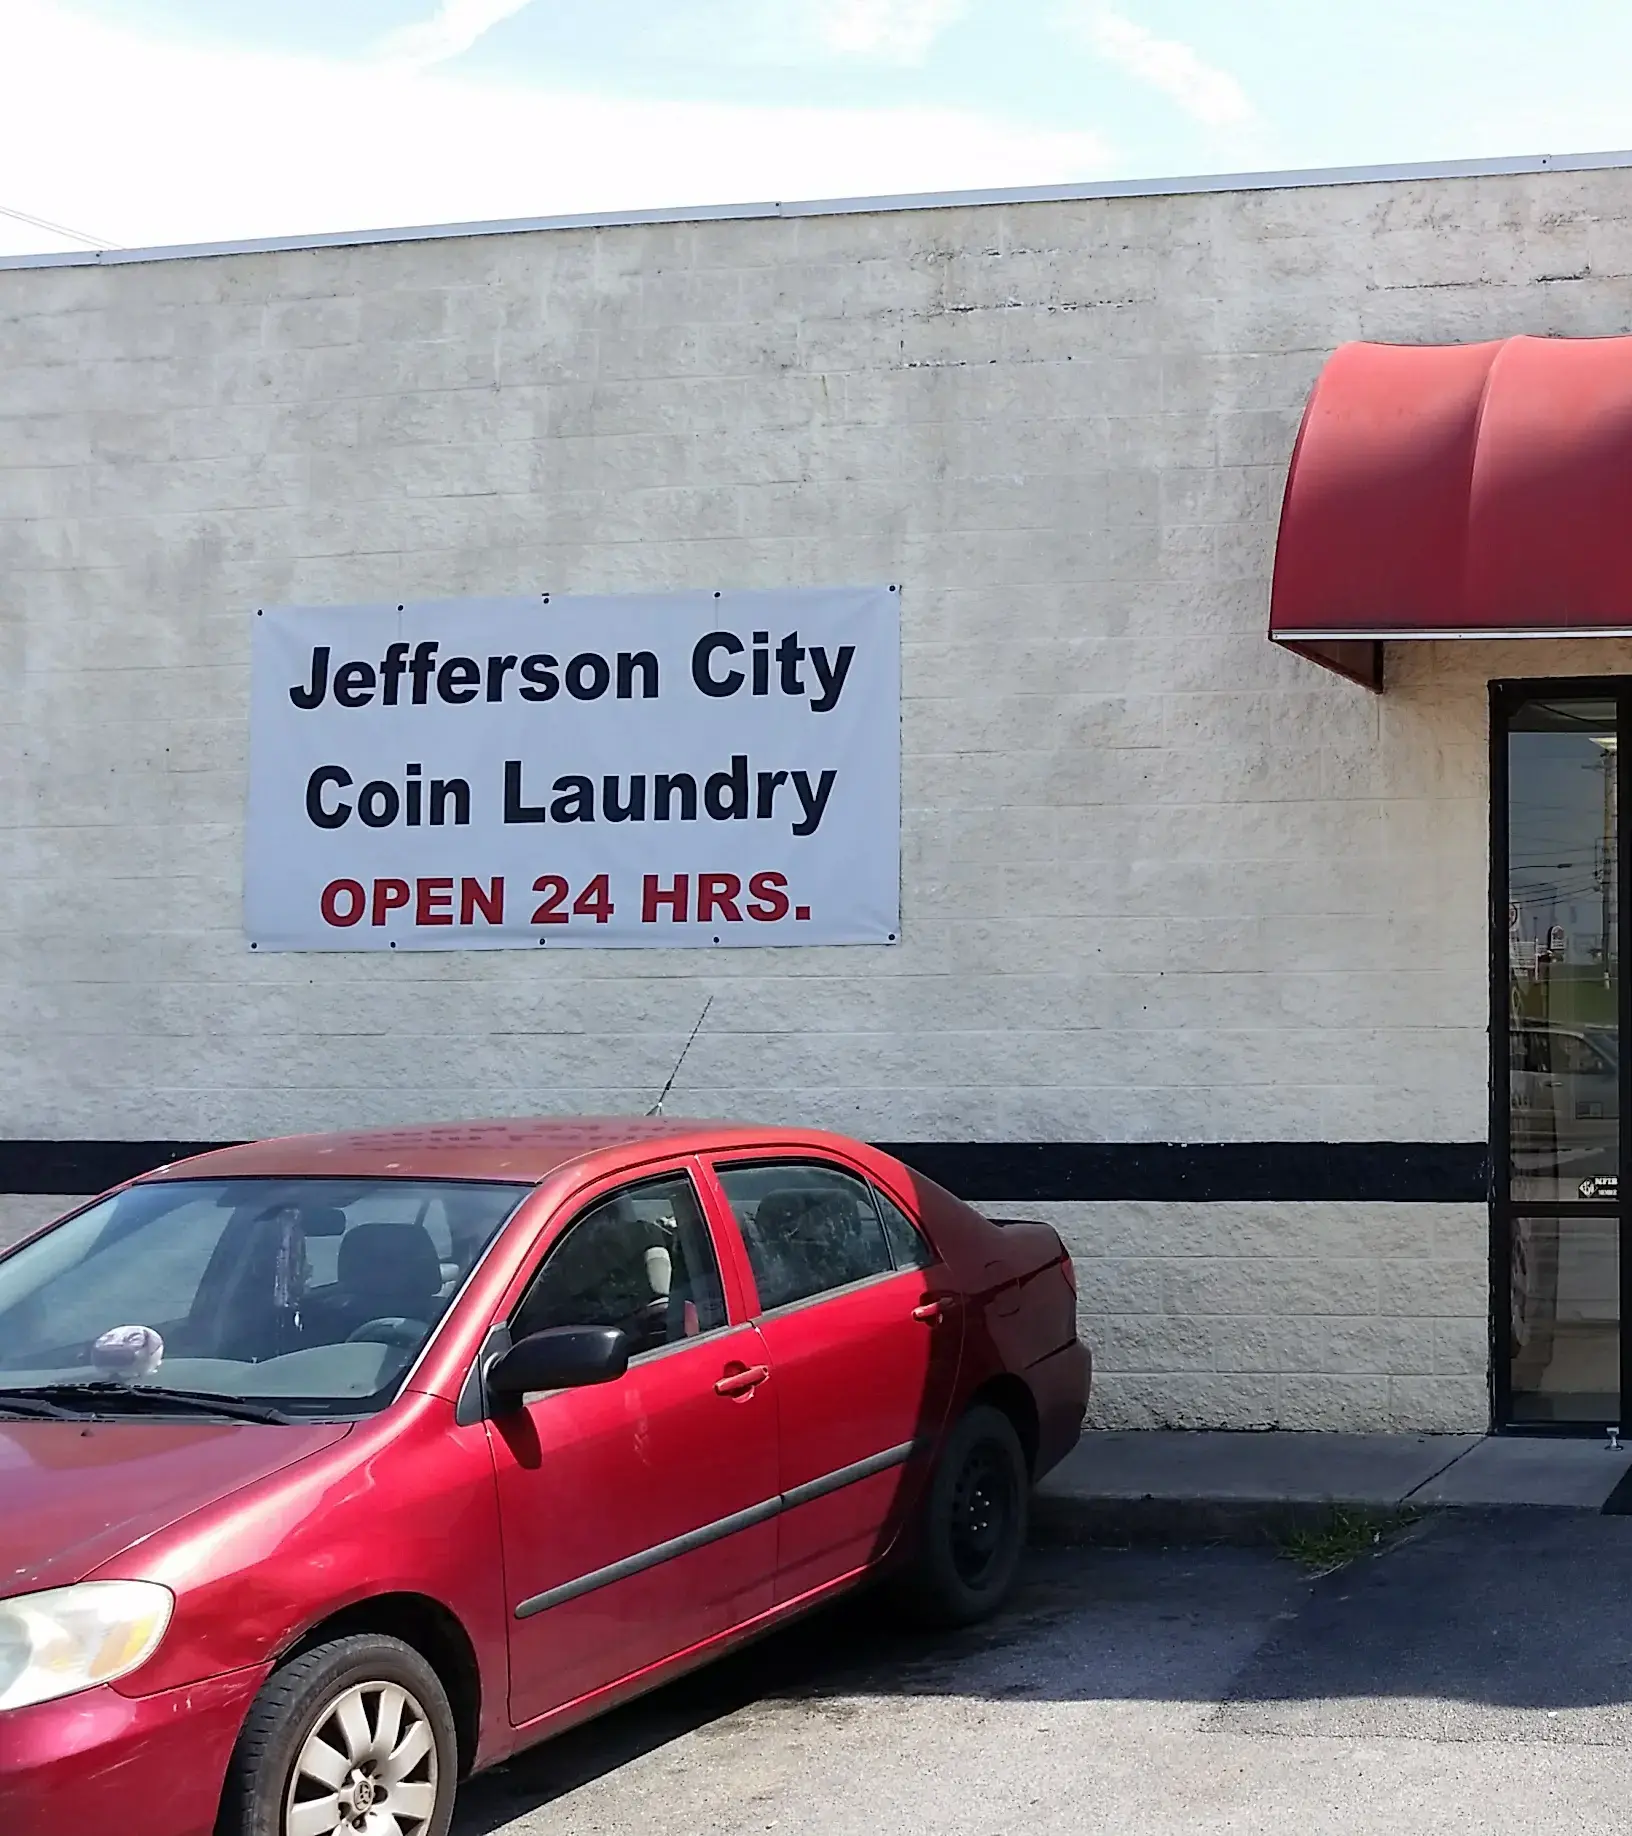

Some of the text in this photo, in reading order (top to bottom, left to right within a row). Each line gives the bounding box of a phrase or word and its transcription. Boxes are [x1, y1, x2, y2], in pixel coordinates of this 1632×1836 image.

[288, 630, 857, 712] Jefferson City
[305, 754, 838, 837] Coin Laundry
[319, 872, 812, 928] OPEN 24 HRS.
